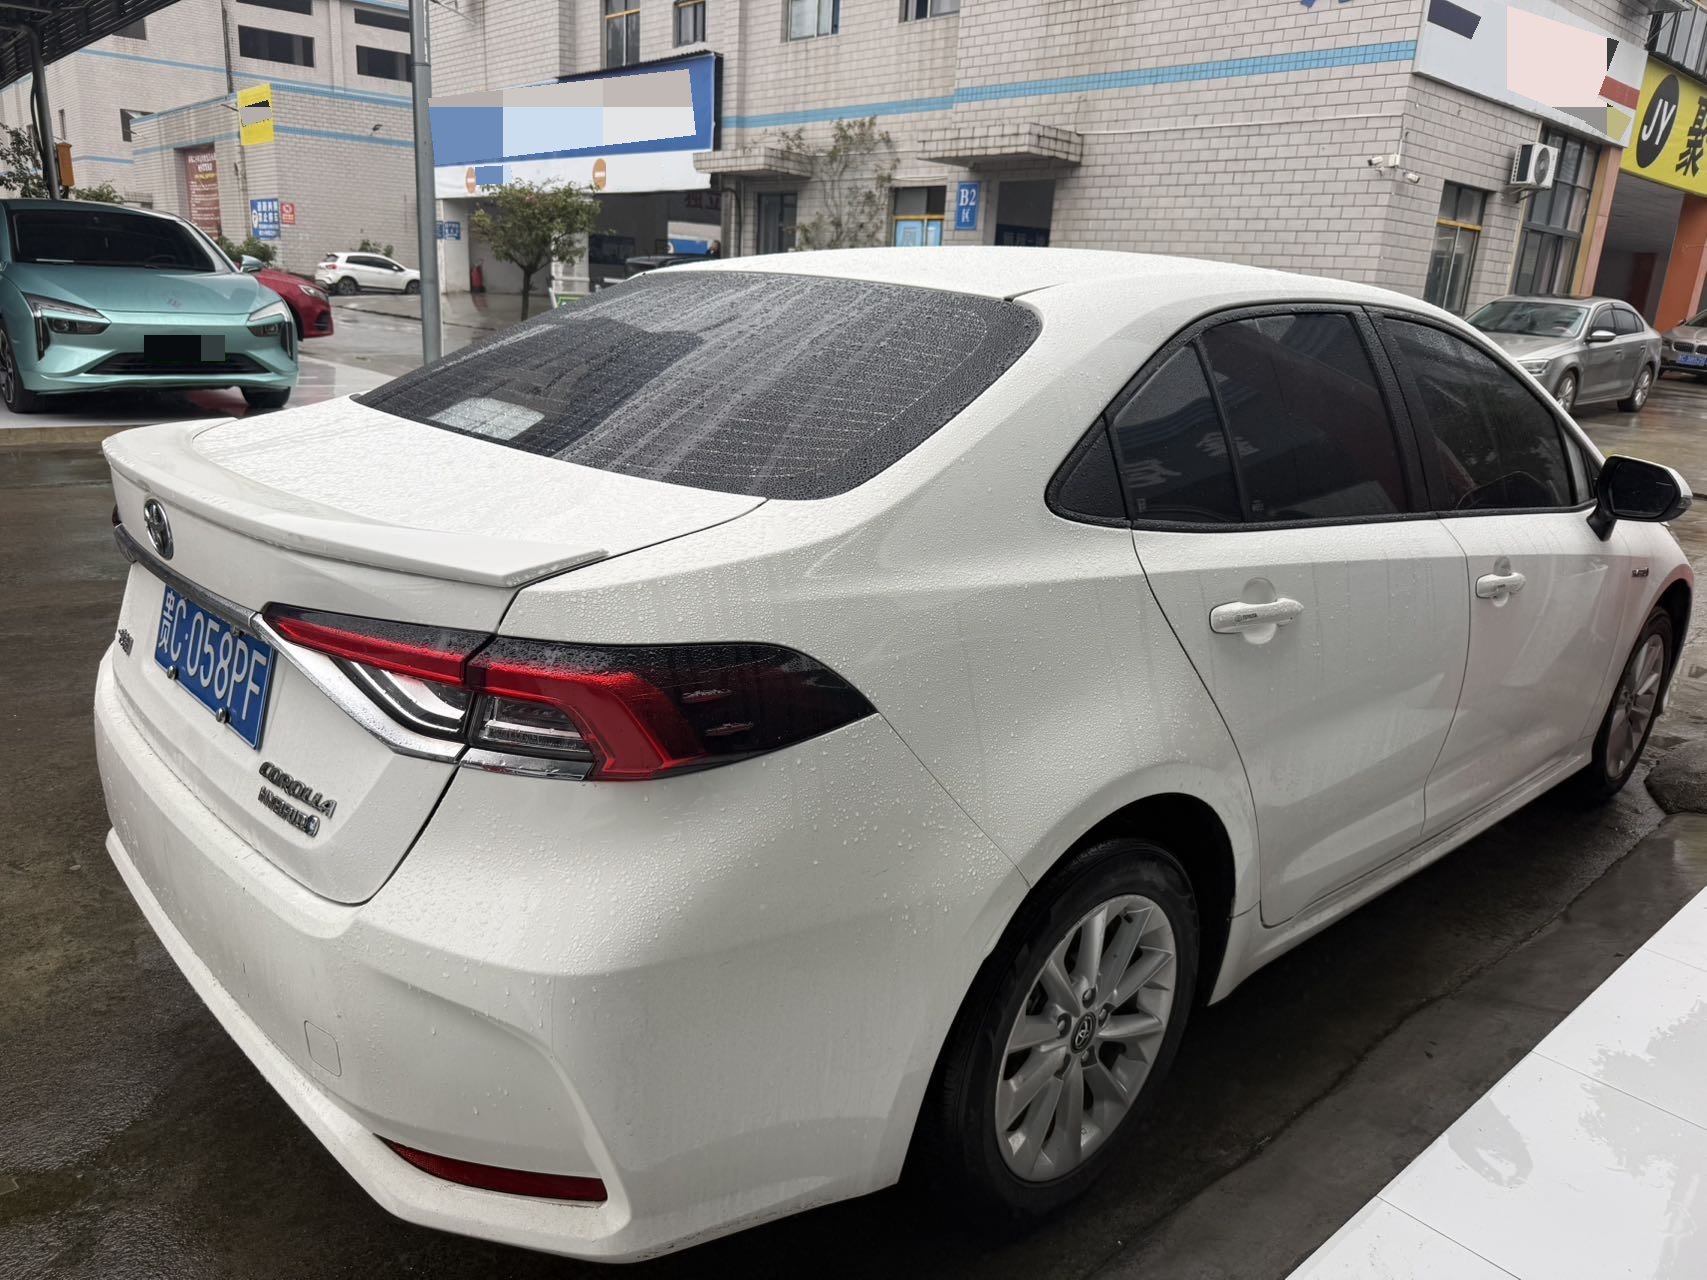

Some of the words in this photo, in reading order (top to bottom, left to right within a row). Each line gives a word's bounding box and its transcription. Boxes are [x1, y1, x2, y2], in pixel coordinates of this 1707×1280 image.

[1641, 98, 1677, 146] JY
[959, 188, 977, 206] B2
[258, 761, 338, 820] COROLLA
